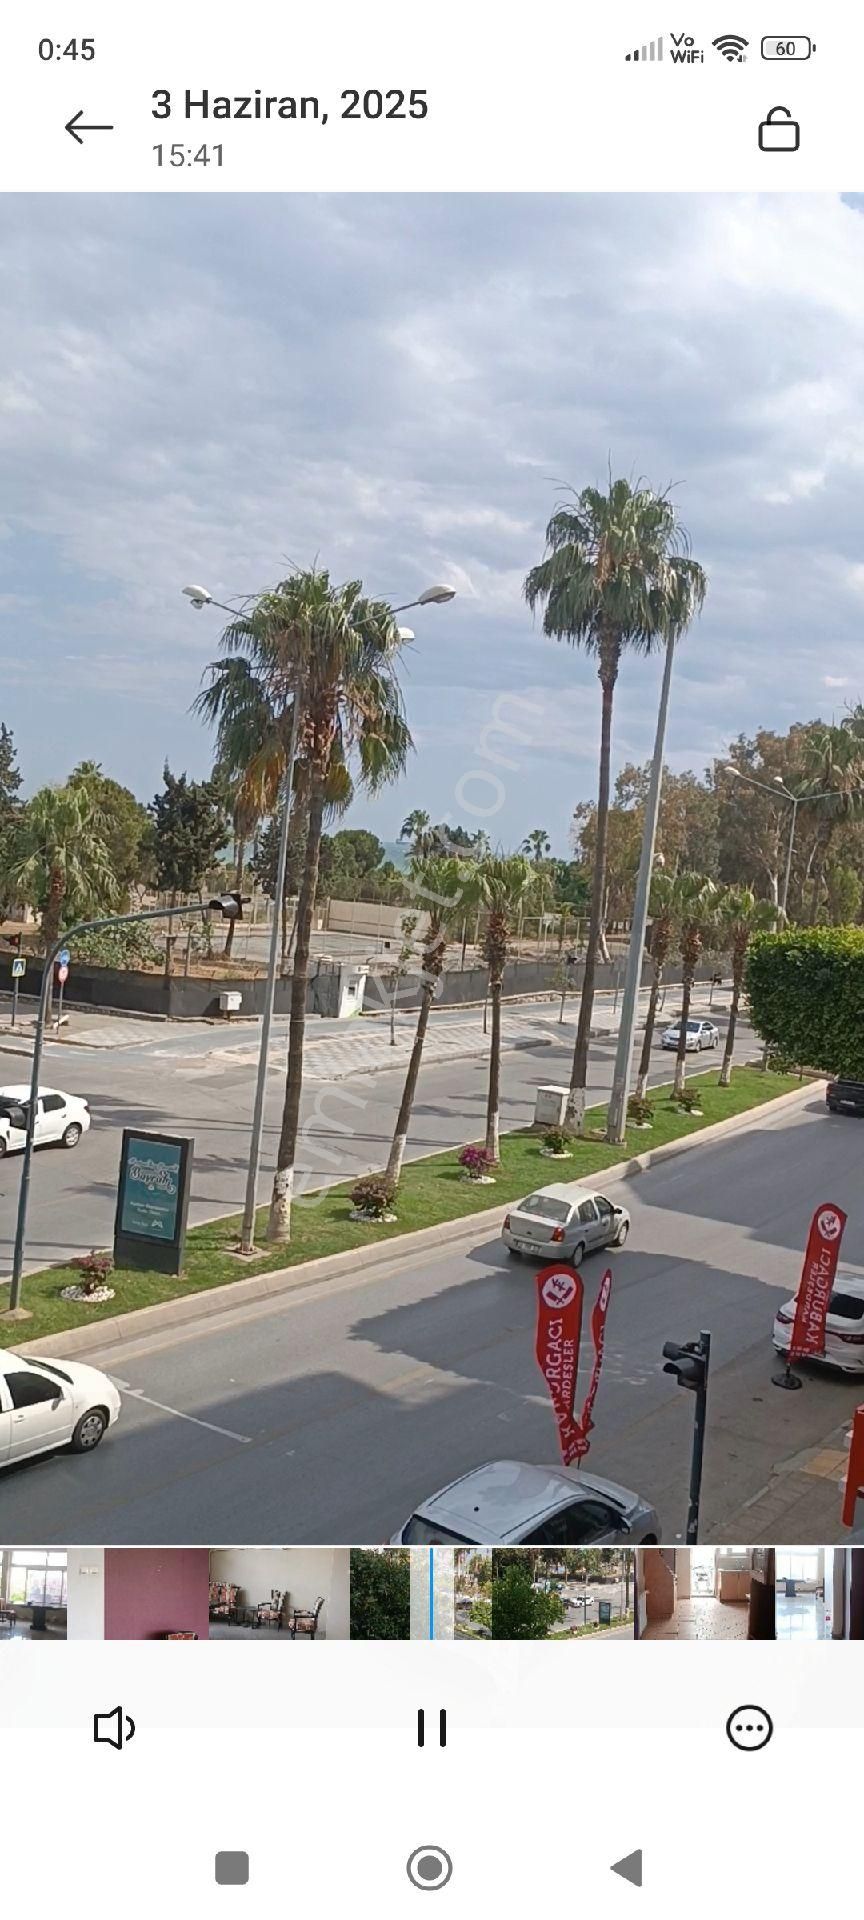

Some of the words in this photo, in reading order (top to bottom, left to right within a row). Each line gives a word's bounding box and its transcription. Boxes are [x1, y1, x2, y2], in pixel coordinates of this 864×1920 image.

[669, 32, 695, 47] Vo
[775, 41, 796, 56] 60
[38, 38, 95, 61] 0:45
[669, 49, 704, 64] WiFi
[151, 89, 171, 119] 3
[185, 89, 328, 125] Haziran,
[340, 89, 428, 119] 2025
[152, 143, 223, 167] 15:41
